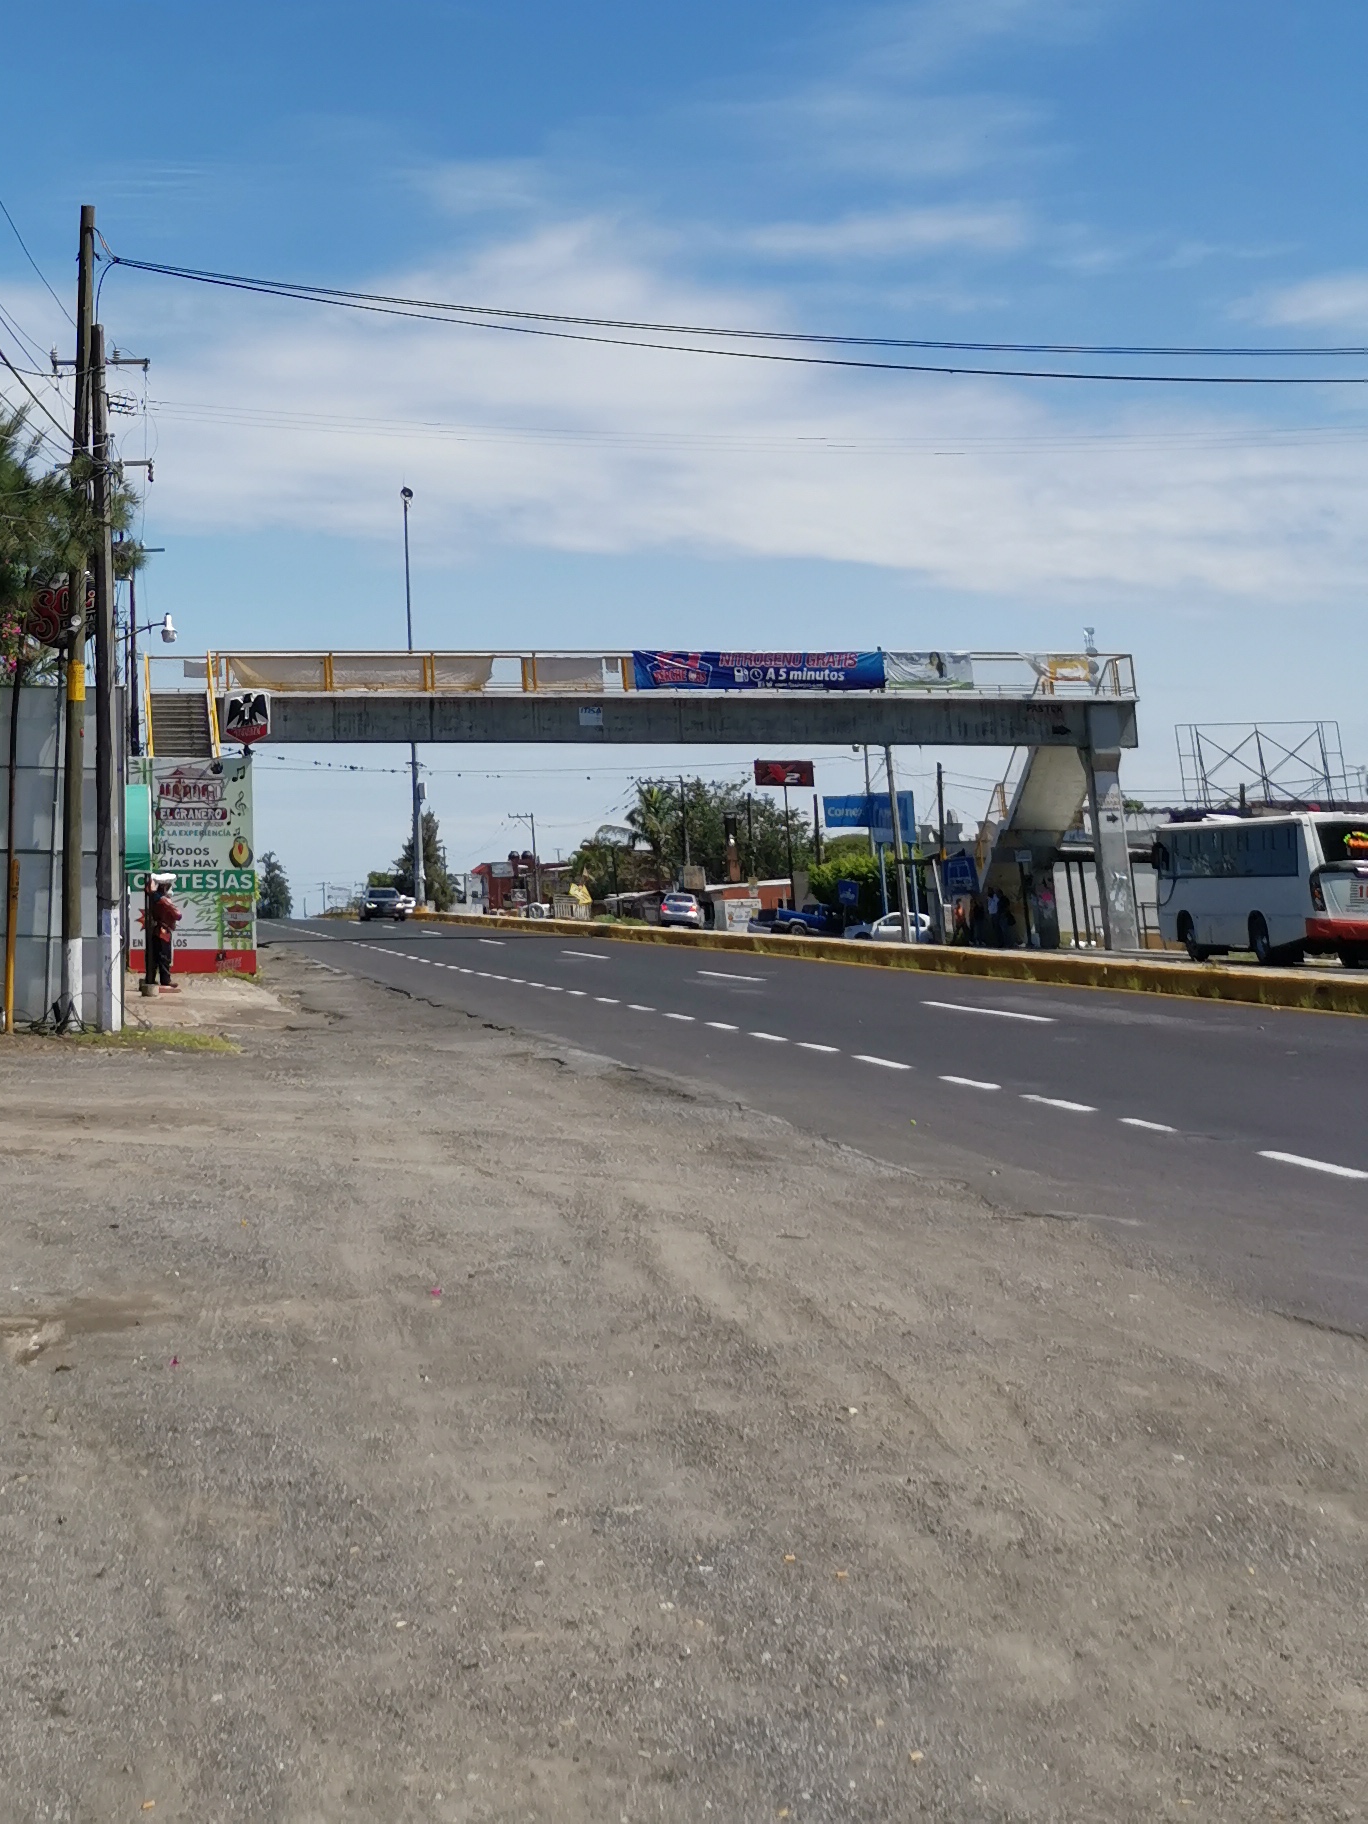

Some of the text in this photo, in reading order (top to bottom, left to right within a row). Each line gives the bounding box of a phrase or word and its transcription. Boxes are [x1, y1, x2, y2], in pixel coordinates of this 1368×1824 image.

[805, 653, 858, 668] GRATIS
[765, 668, 846, 681] A 5 minutos
[160, 807, 223, 820] EL GRANERO
[171, 847, 210, 856] TODOS
[160, 858, 190, 867] DÍAS
[193, 859, 219, 867] HAY
[133, 870, 253, 889] CTESÍAS
[132, 939, 143, 947] EN
